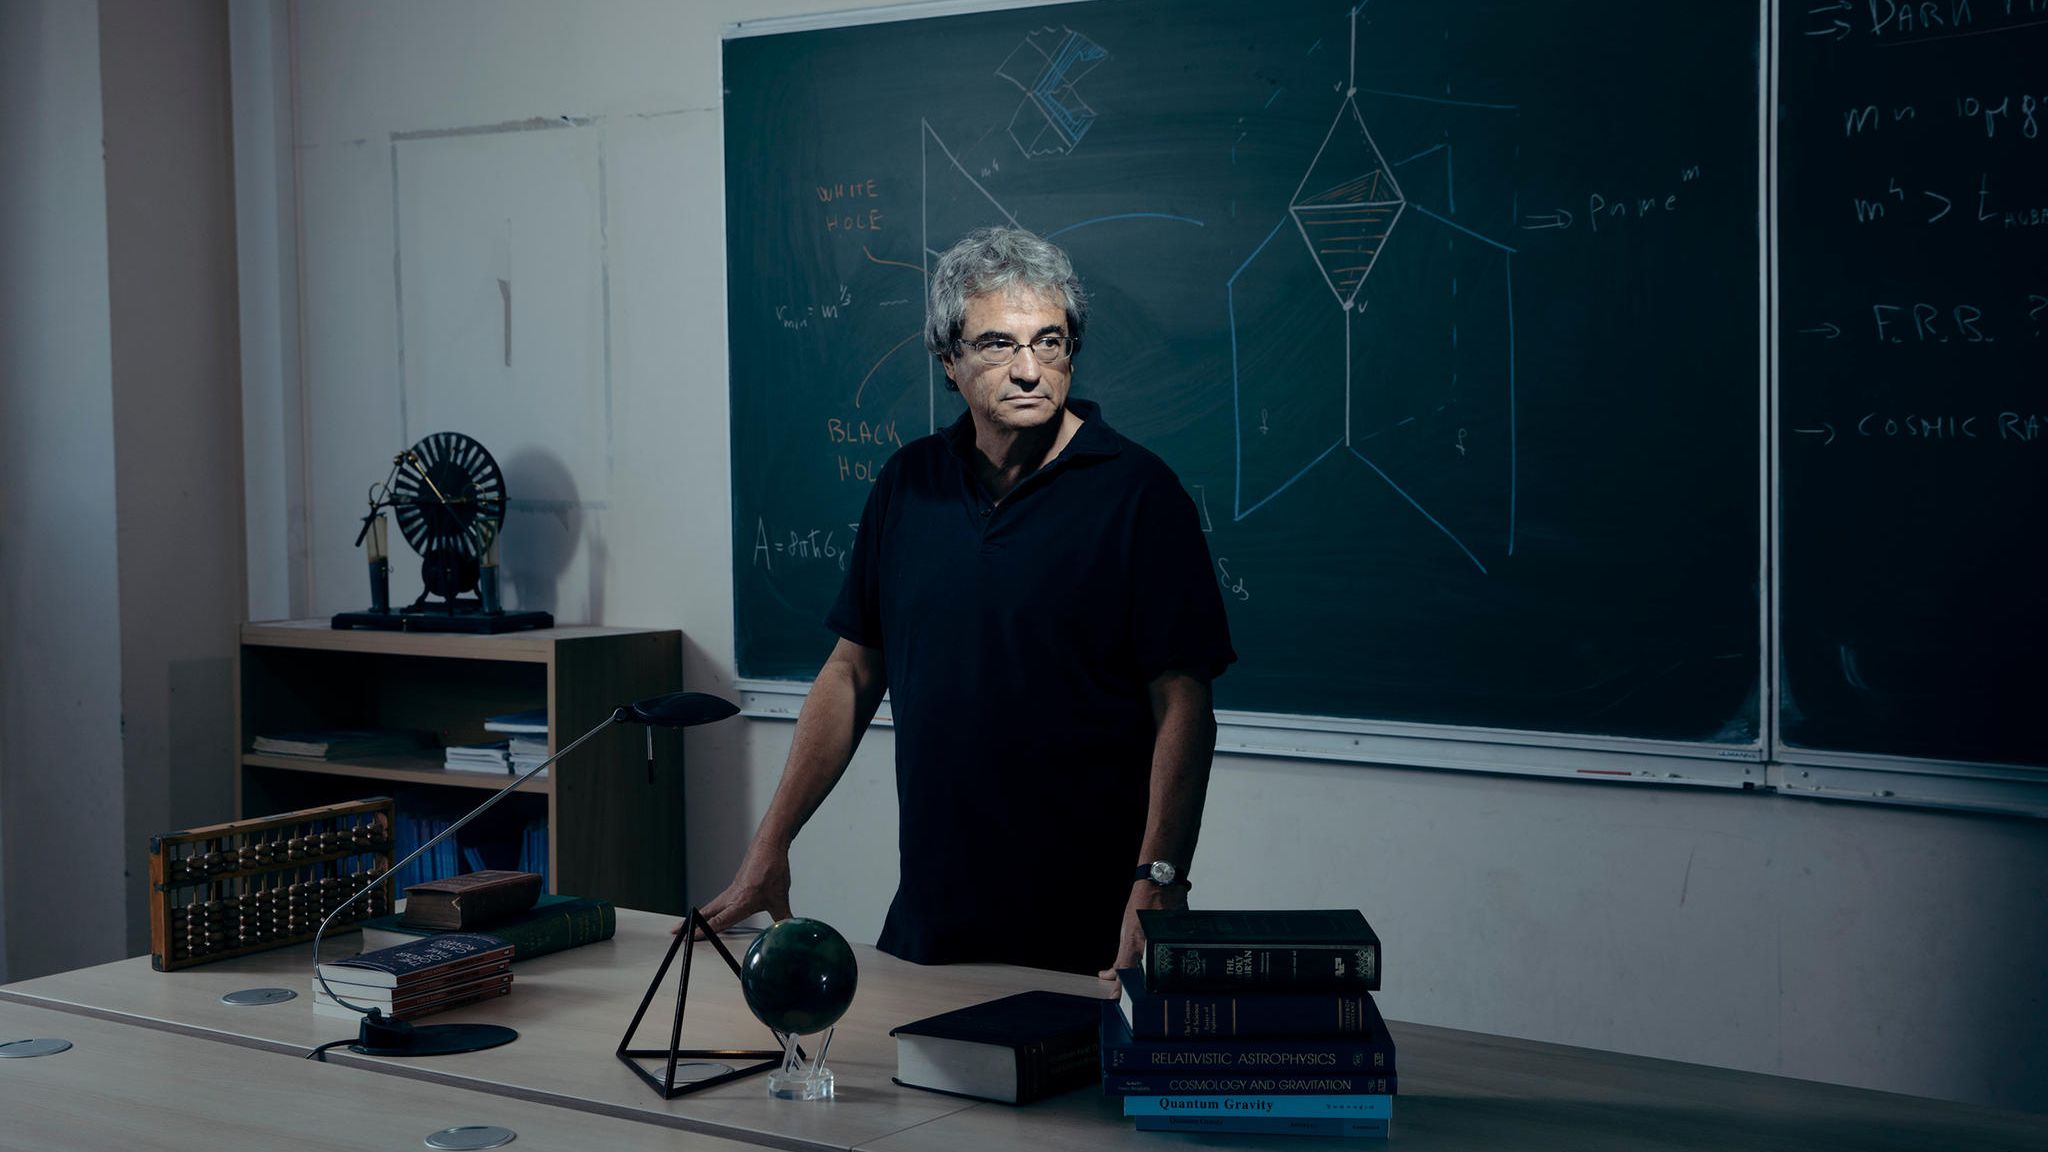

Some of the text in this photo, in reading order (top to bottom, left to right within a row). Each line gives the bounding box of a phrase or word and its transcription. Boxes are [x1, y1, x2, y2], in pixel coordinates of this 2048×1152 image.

[816, 178, 879, 203] WHITE
[826, 208, 883, 232] HOLE
[827, 418, 904, 449] BLACK
[1858, 411, 2048, 441] COSMIC RA
[837, 454, 884, 484] HOL
[1151, 1051, 1337, 1066] RELATIVISTIC ASTROPHYSICS
[1168, 1079, 1352, 1091] COSMOLOGY AND GRAVITATION
[1159, 1097, 1273, 1112] Quantum Gravity
